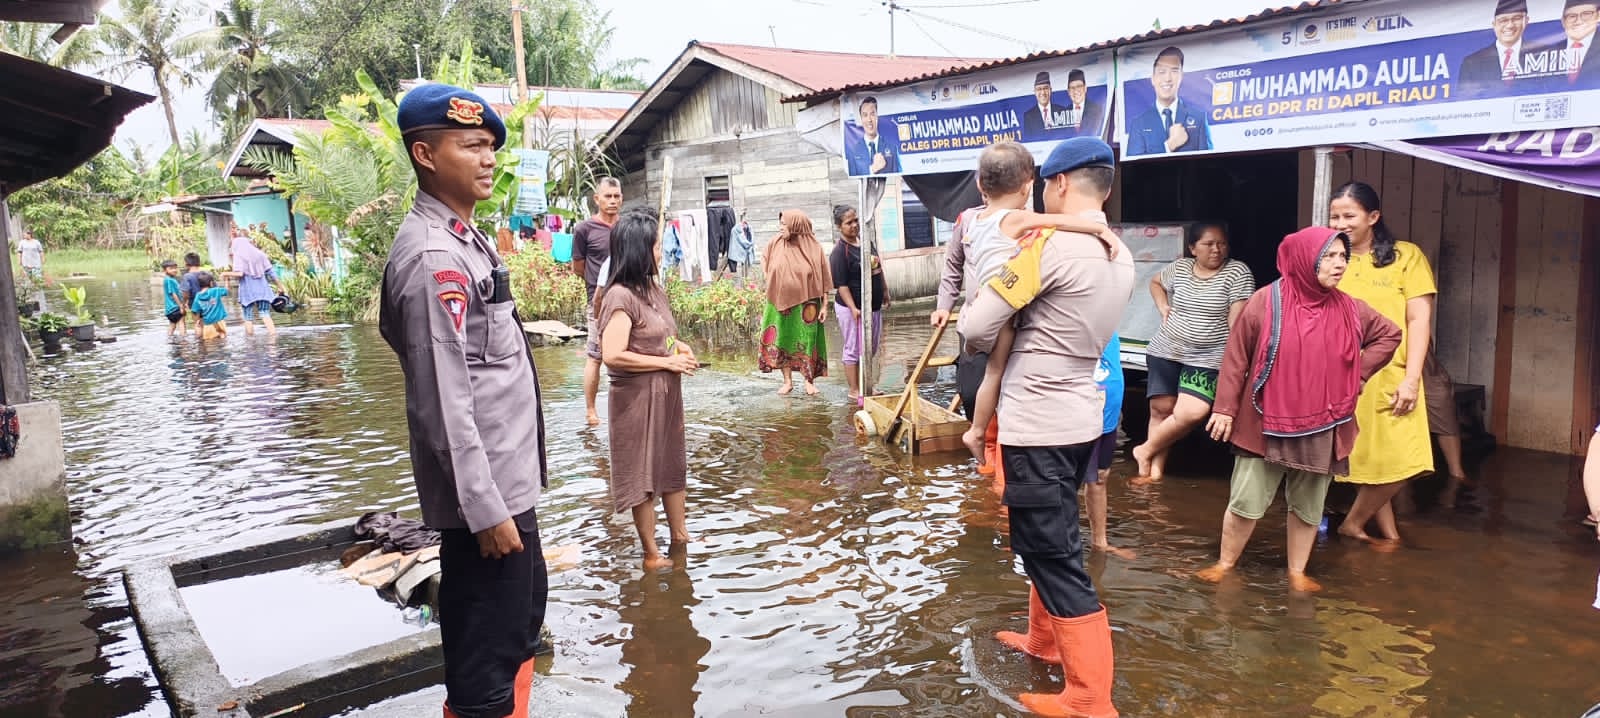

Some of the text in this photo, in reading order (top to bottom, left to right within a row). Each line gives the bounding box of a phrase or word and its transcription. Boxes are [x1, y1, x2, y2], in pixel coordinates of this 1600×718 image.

[1281, 32, 1292, 45] 5
[1215, 68, 1252, 80] COBLOS
[1502, 48, 1580, 76] AMIN
[1239, 63, 1368, 102] MUHAMMAD
[1374, 53, 1450, 87] AULIA
[931, 90, 937, 101] 5
[1212, 83, 1450, 121] CALEG DPR RI DAPIL RIAU 1
[913, 115, 980, 139] MUHAMMAD
[984, 109, 1020, 133] AULIA
[900, 130, 1022, 152] CALEG DPR RI DAPIL RIAU 1
